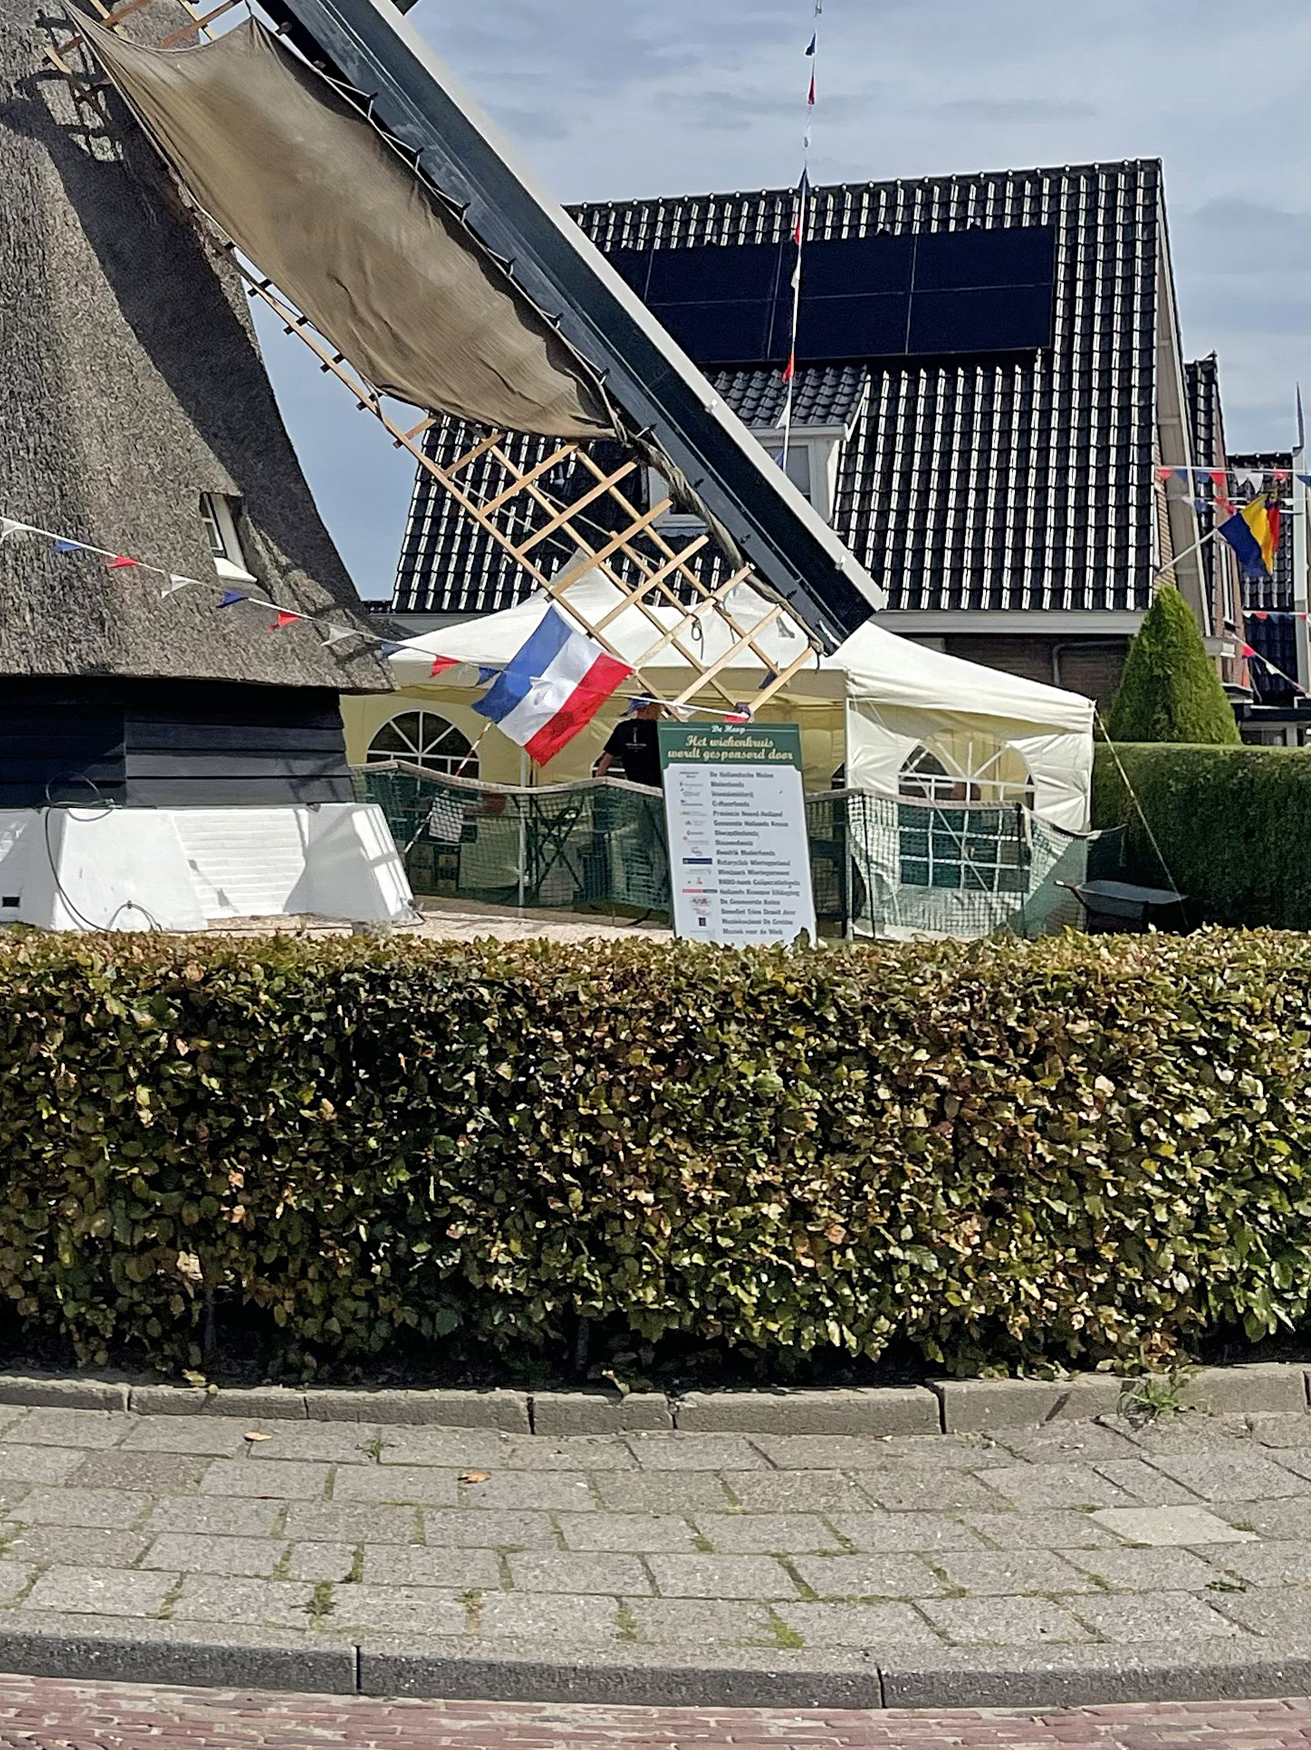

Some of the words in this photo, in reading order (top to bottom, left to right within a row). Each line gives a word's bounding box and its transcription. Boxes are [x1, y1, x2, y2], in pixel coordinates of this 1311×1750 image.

[685, 735, 707, 747] Het
[667, 747, 700, 758] wordt
[768, 748, 793, 760] door
